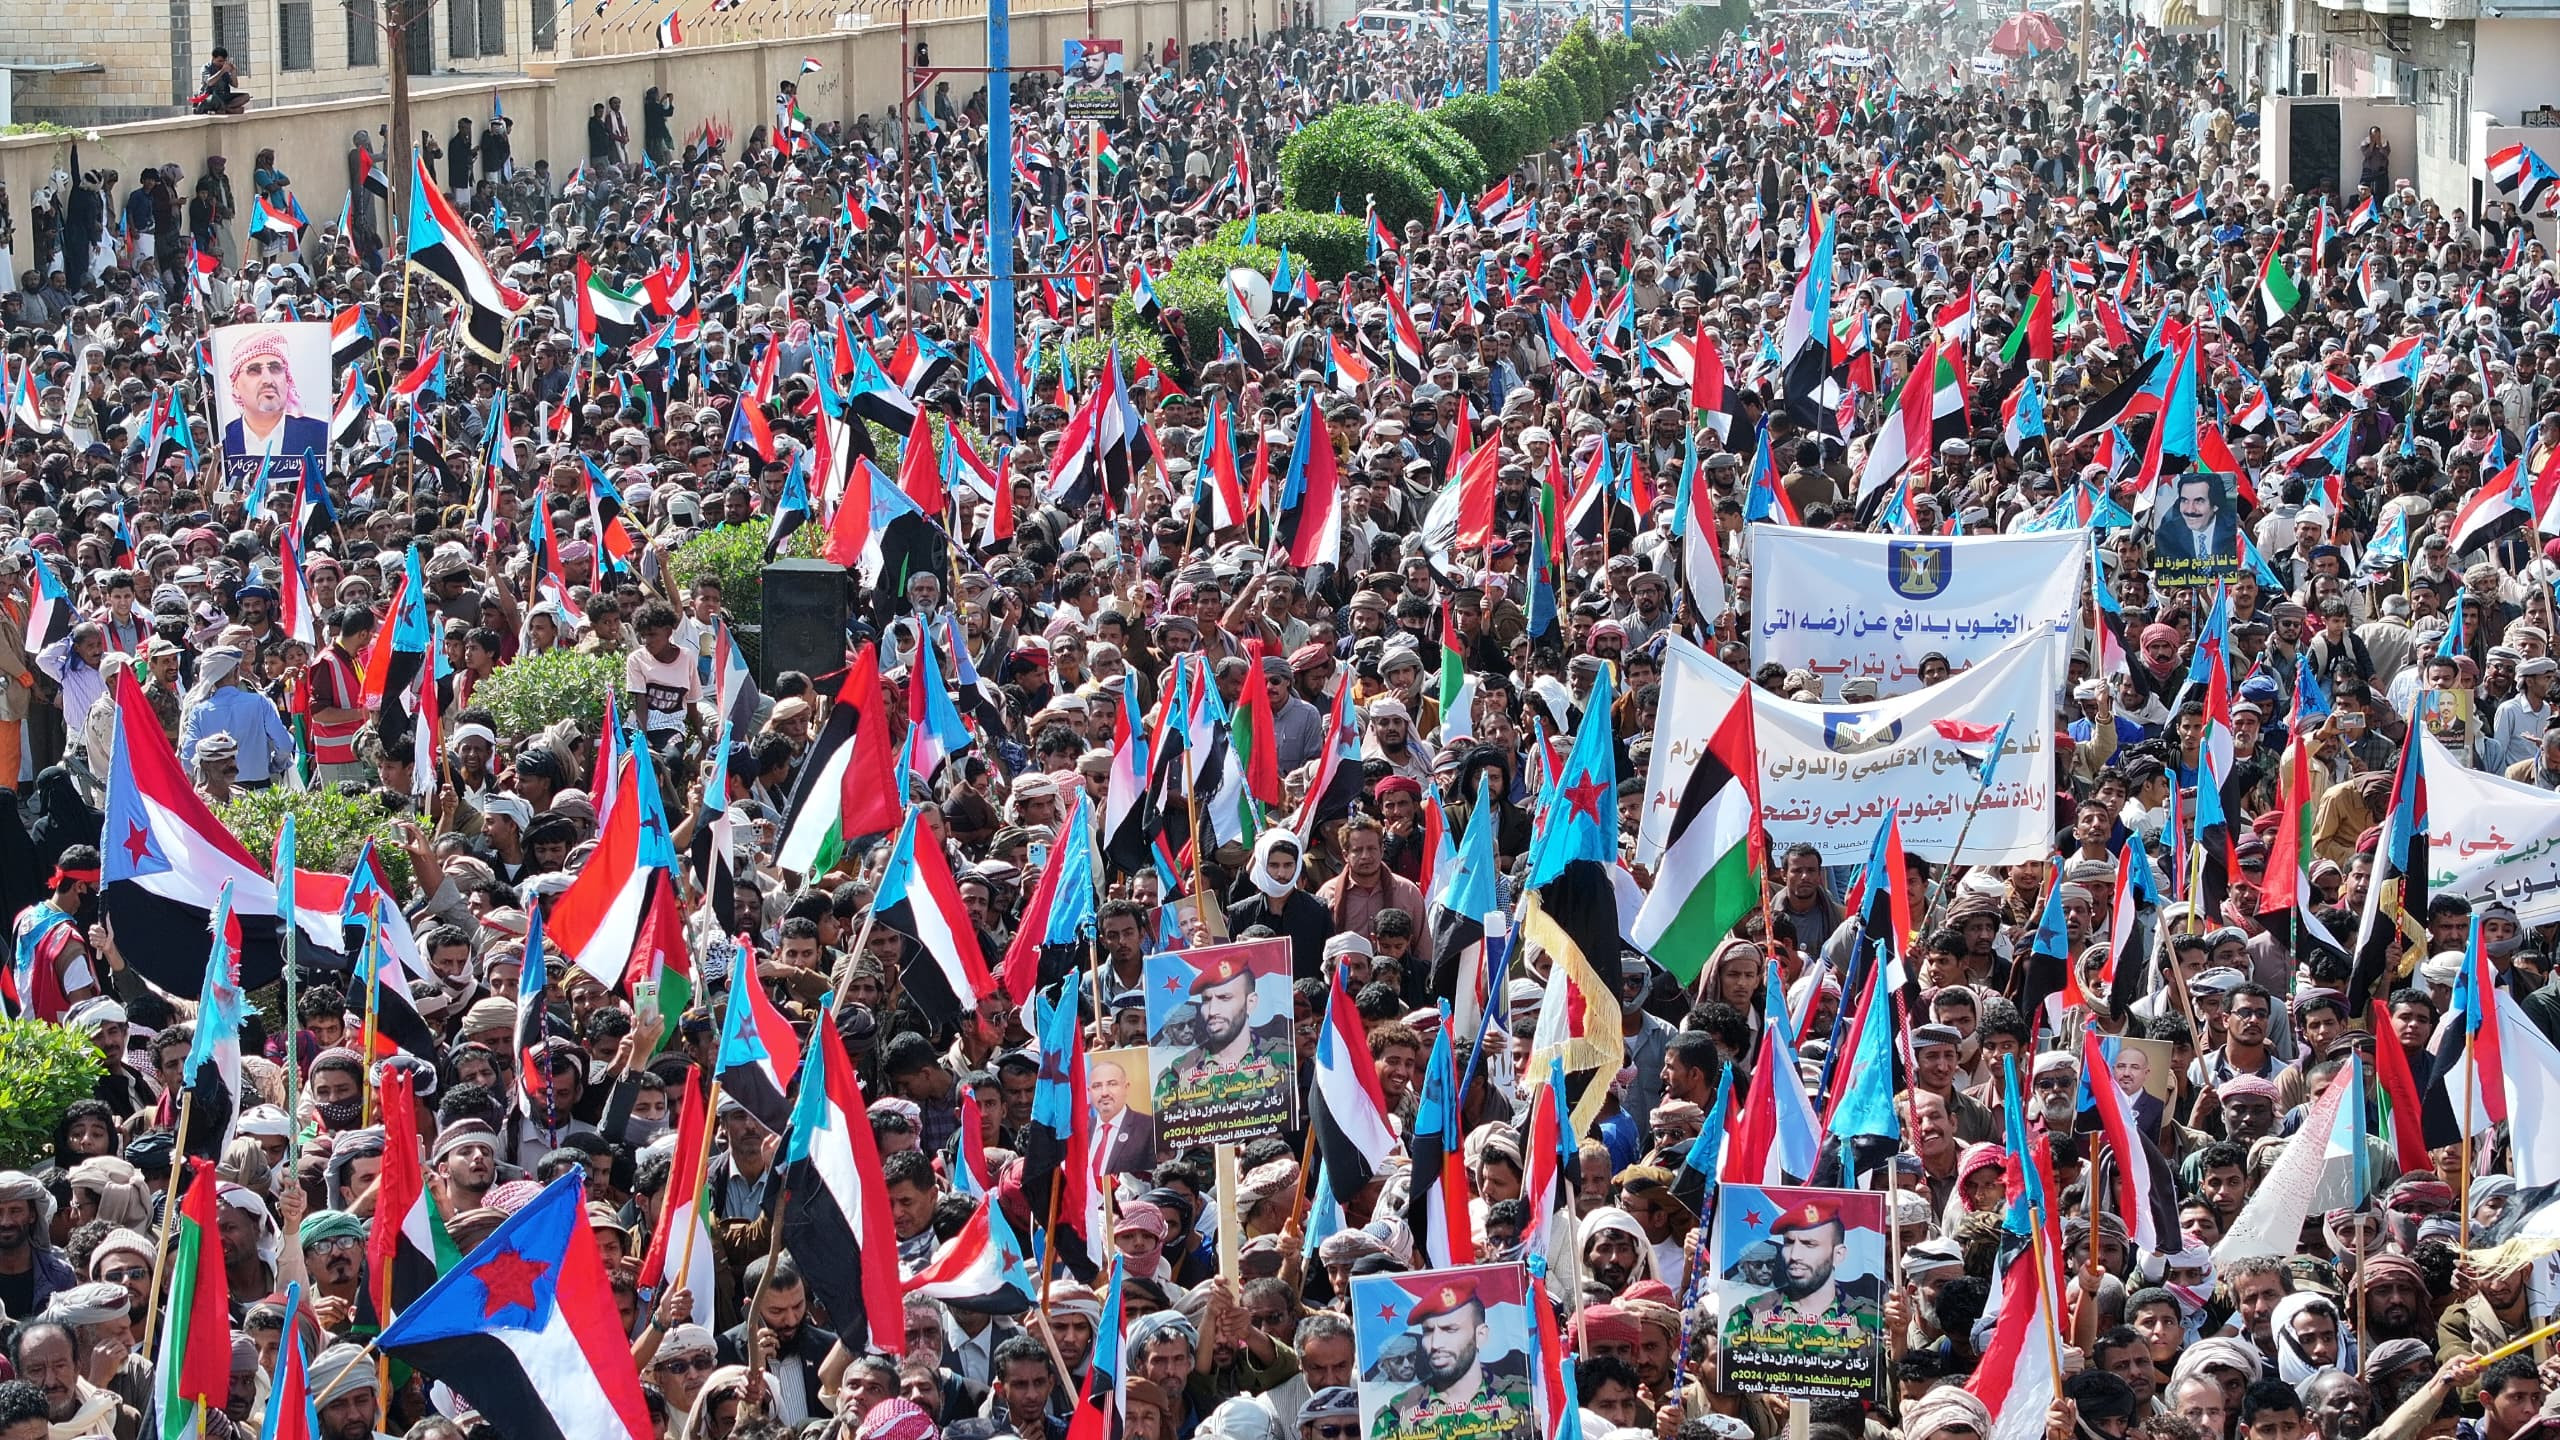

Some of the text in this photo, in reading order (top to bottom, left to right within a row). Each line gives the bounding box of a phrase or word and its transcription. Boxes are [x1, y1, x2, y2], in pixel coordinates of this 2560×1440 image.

[1762, 609, 1796, 640] التي
[1799, 603, 1851, 636] أرضه
[1853, 612, 1888, 638] عن
[1893, 611, 1950, 640] يدافع
[1955, 611, 2024, 641] الجنوب
[1999, 729, 2041, 754] ندع
[1769, 754, 1848, 783] والدولي
[1852, 745, 1927, 783] الاقليمي
[2011, 782, 2045, 812] إرادة
[1824, 795, 1891, 829] العربي
[1898, 792, 1959, 826] الجنوب
[1218, 1080, 1252, 1098] محسن
[1202, 1105, 1221, 1117] الاول
[1222, 1102, 1242, 1114] اللواء
[1242, 1100, 1261, 1111] حرب
[1164, 1109, 1184, 1122] شبوة
[1228, 1114, 1268, 1128] الاستشهاد
[1268, 1110, 1288, 1124] تاريخ
[1234, 1128, 1262, 1139] منطقة
[1262, 1126, 1278, 1136] في
[1170, 1137, 1193, 1149] شبوة
[1794, 1331, 1834, 1350] محسن
[1732, 1350, 1754, 1364] شبوة
[1775, 1354, 1798, 1366] الاول
[1798, 1356, 1820, 1366] اللواء
[1820, 1359, 1842, 1370] حرب
[1804, 1374, 1850, 1386] الاستشهاد
[1850, 1376, 1872, 1389] تاريخ
[1738, 1382, 1764, 1394] شبوة
[1810, 1386, 1840, 1397] منطقة
[1842, 1388, 1860, 1400] في
[1446, 1421, 1487, 1440] محسن
